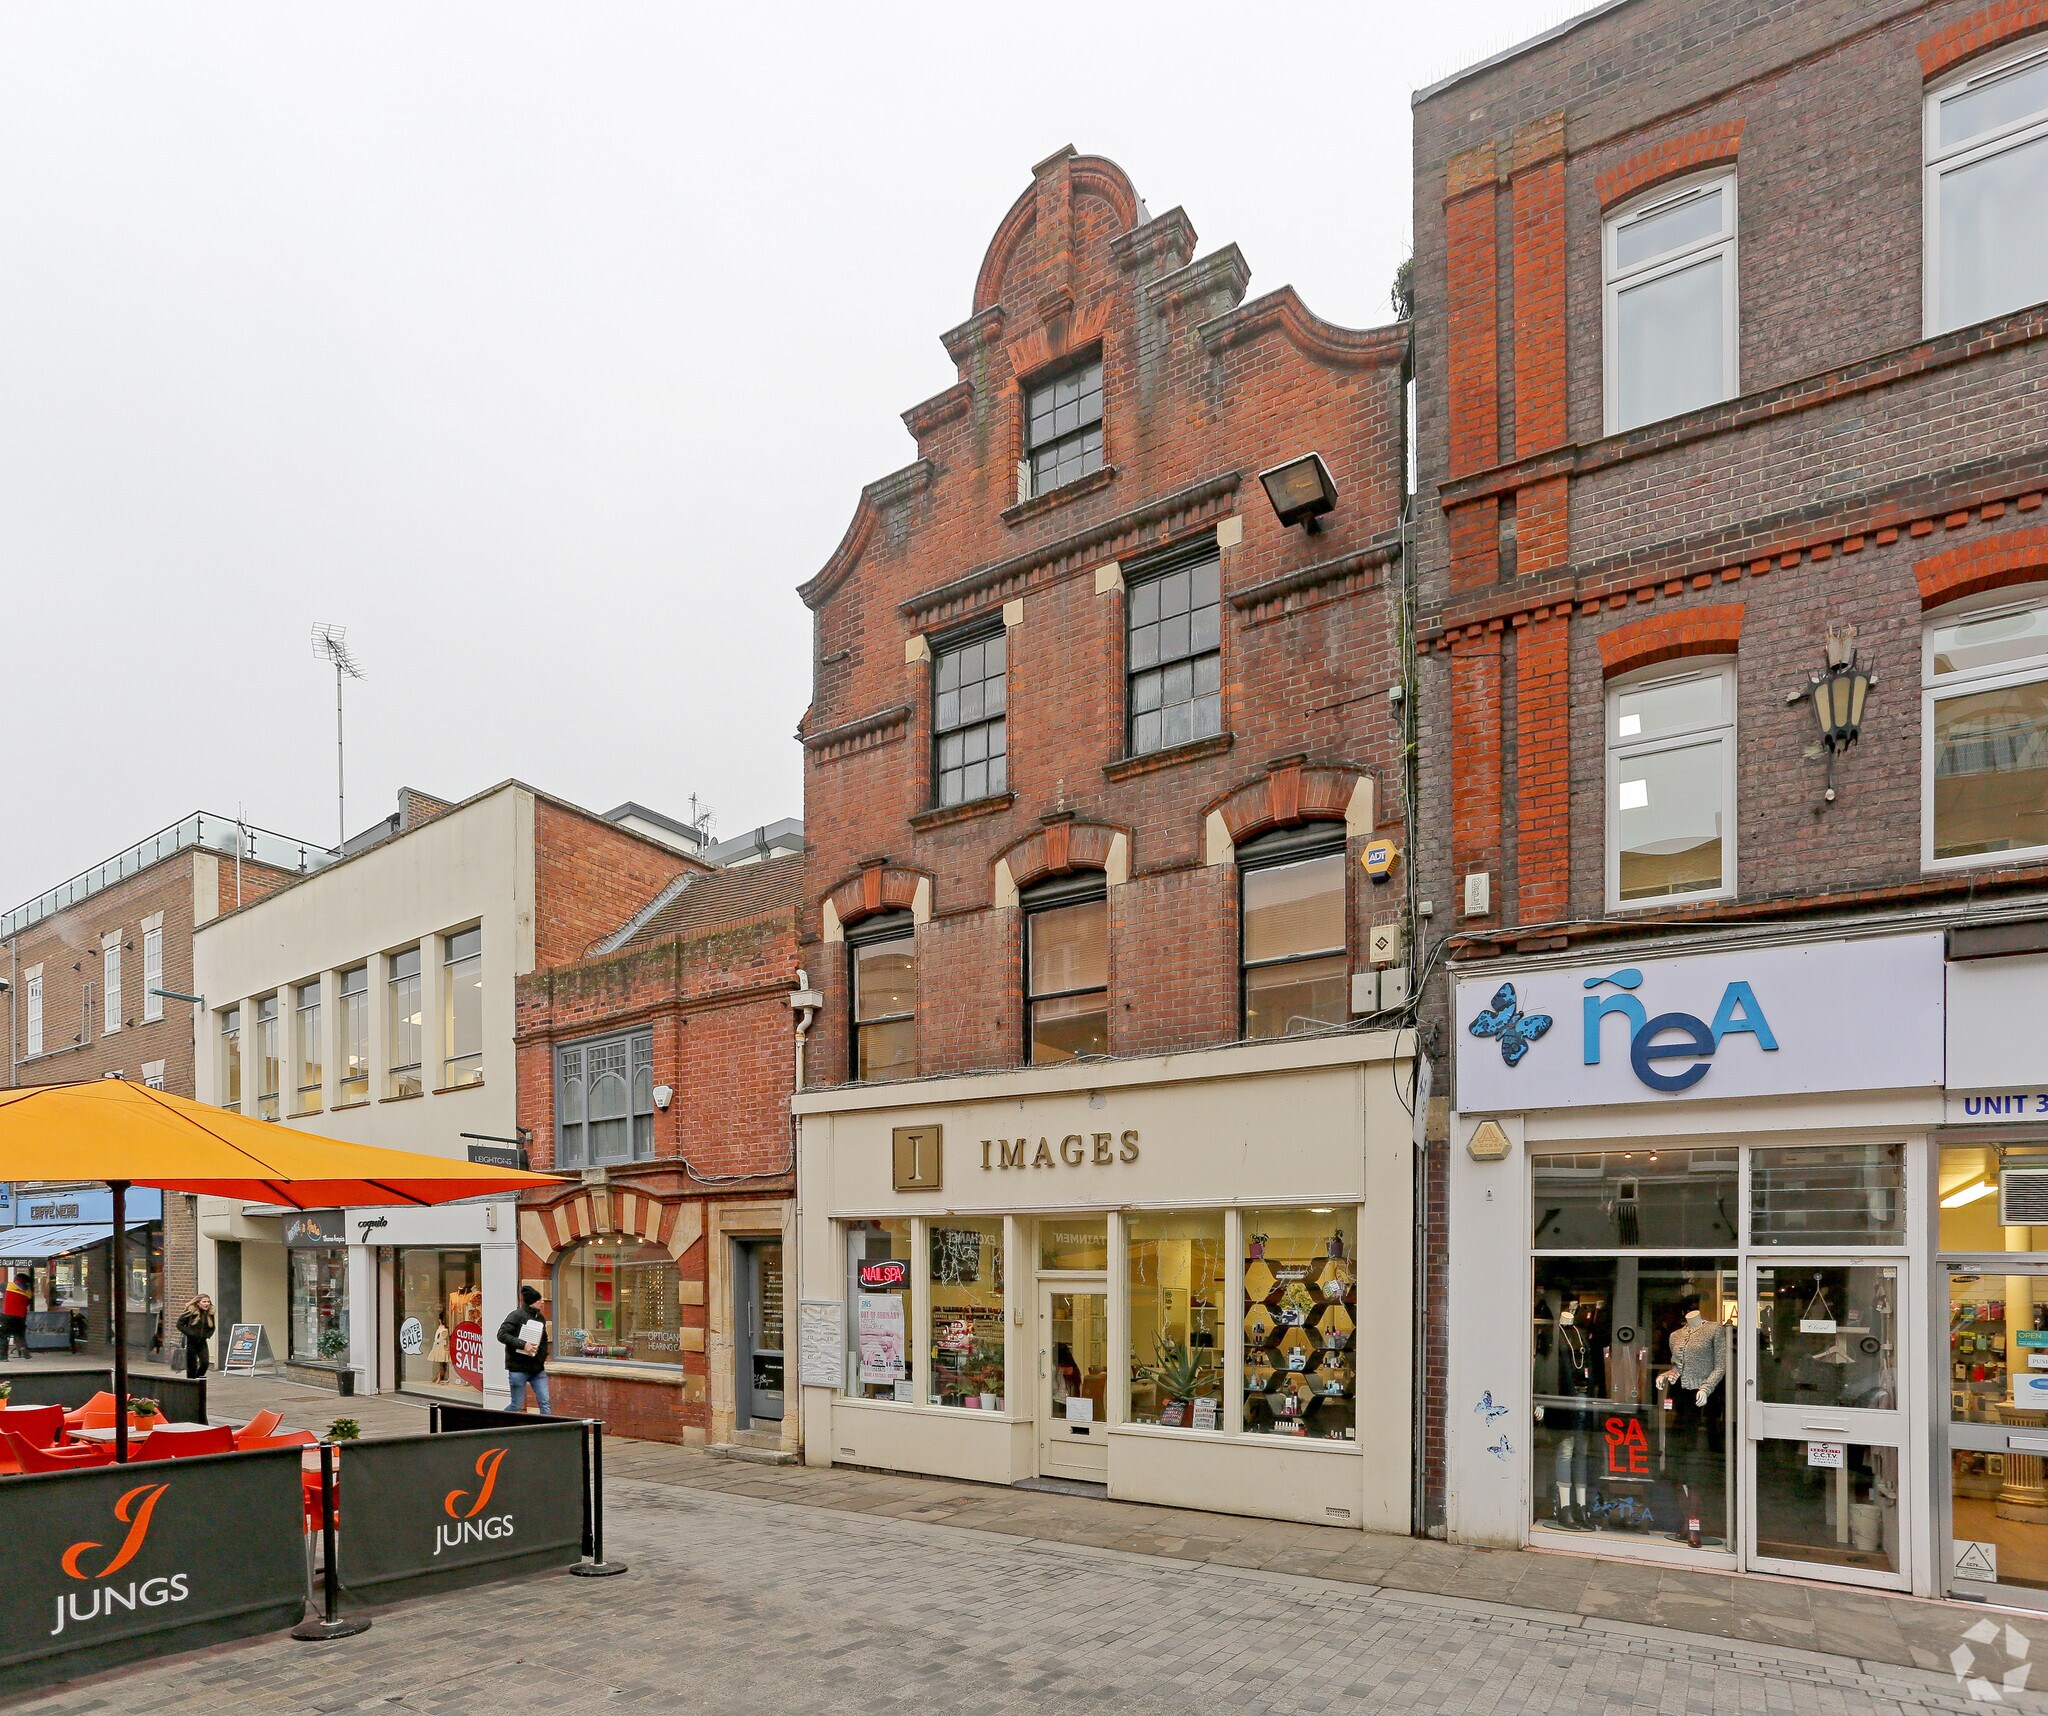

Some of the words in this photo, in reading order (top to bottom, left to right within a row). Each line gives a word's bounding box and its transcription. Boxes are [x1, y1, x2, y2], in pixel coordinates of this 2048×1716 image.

[1369, 850, 1386, 860] ADT
[1964, 1095, 2029, 1116] UNIT
[2035, 1094, 2048, 1113] 3
[908, 1135, 924, 1180] I
[980, 1129, 1140, 1169] IMAGES
[475, 1156, 513, 1165] LEIGHTONS
[862, 1267, 884, 1282] NAIL
[884, 1266, 903, 1282] SPA
[401, 1323, 420, 1338] WINTER
[402, 1331, 421, 1349] SALE
[648, 1343, 672, 1352] HEARING
[456, 1352, 483, 1374] SALE
[433, 1514, 514, 1556] JUNGS
[50, 1573, 189, 1635] JUNGS
